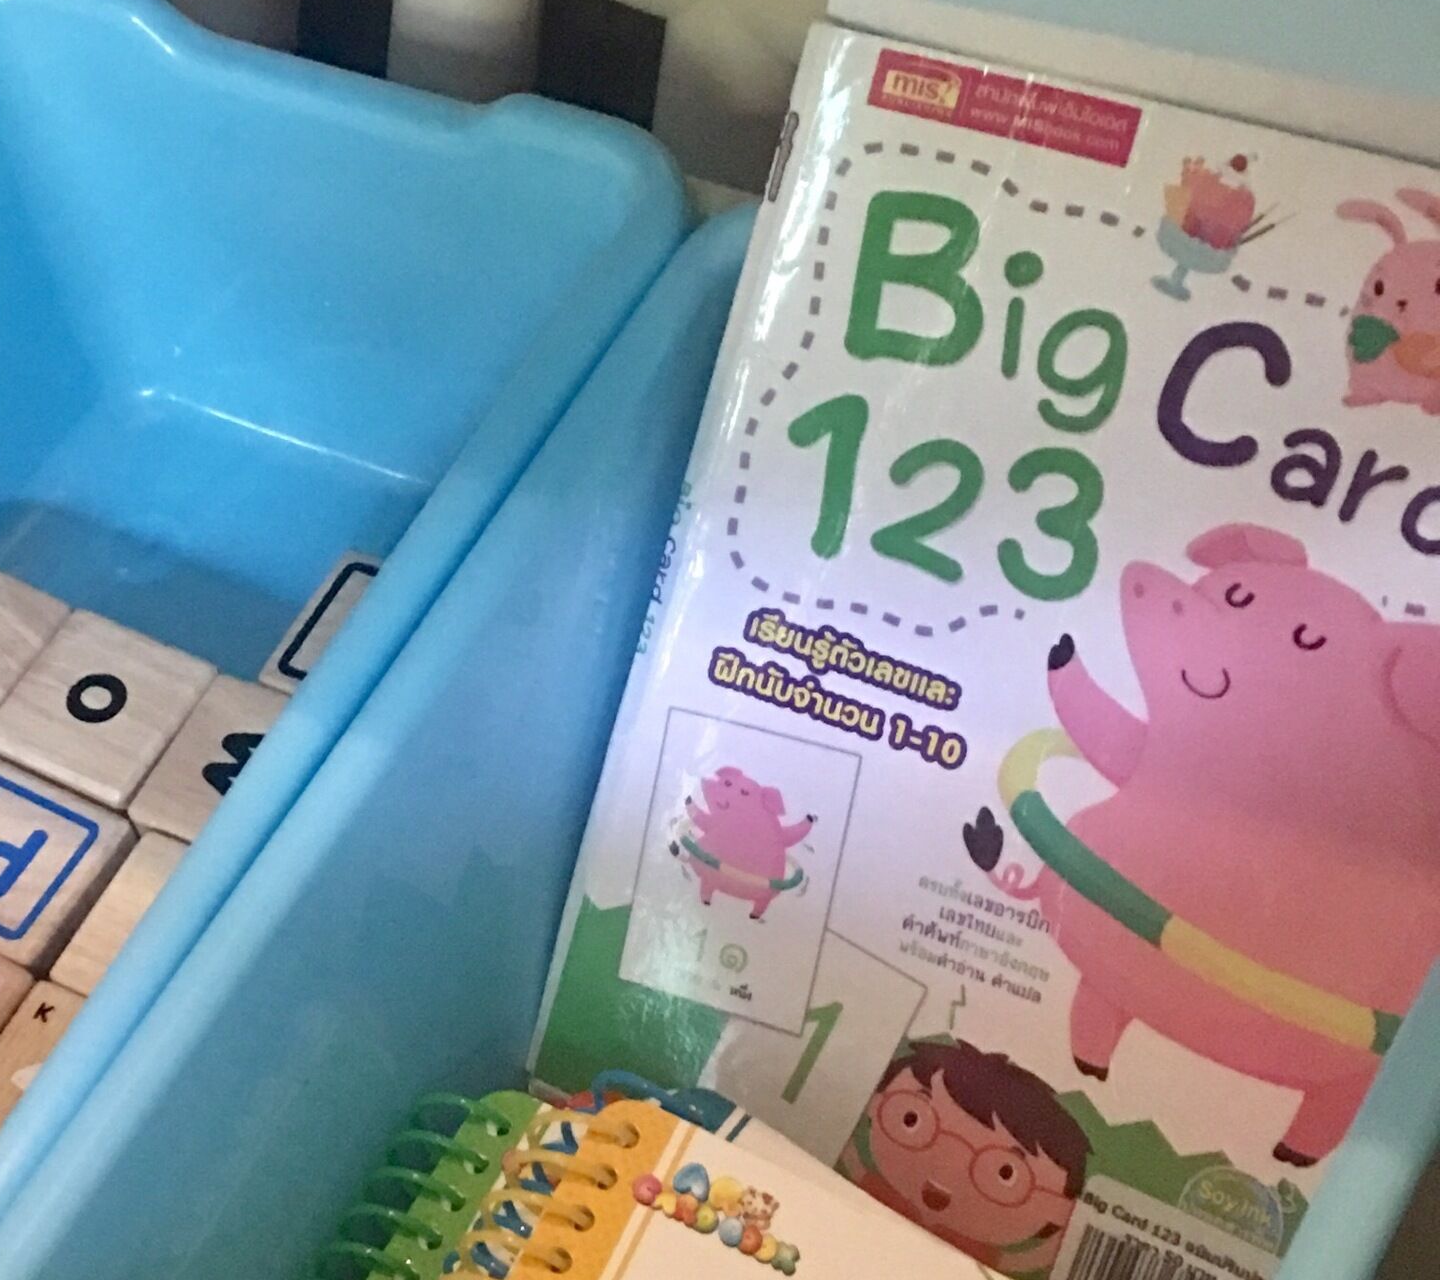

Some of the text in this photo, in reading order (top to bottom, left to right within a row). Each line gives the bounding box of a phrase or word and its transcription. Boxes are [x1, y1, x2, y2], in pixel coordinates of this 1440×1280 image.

[844, 190, 1129, 434] Big
[787, 393, 1105, 603] 123
[890, 714, 966, 770] 1-10
